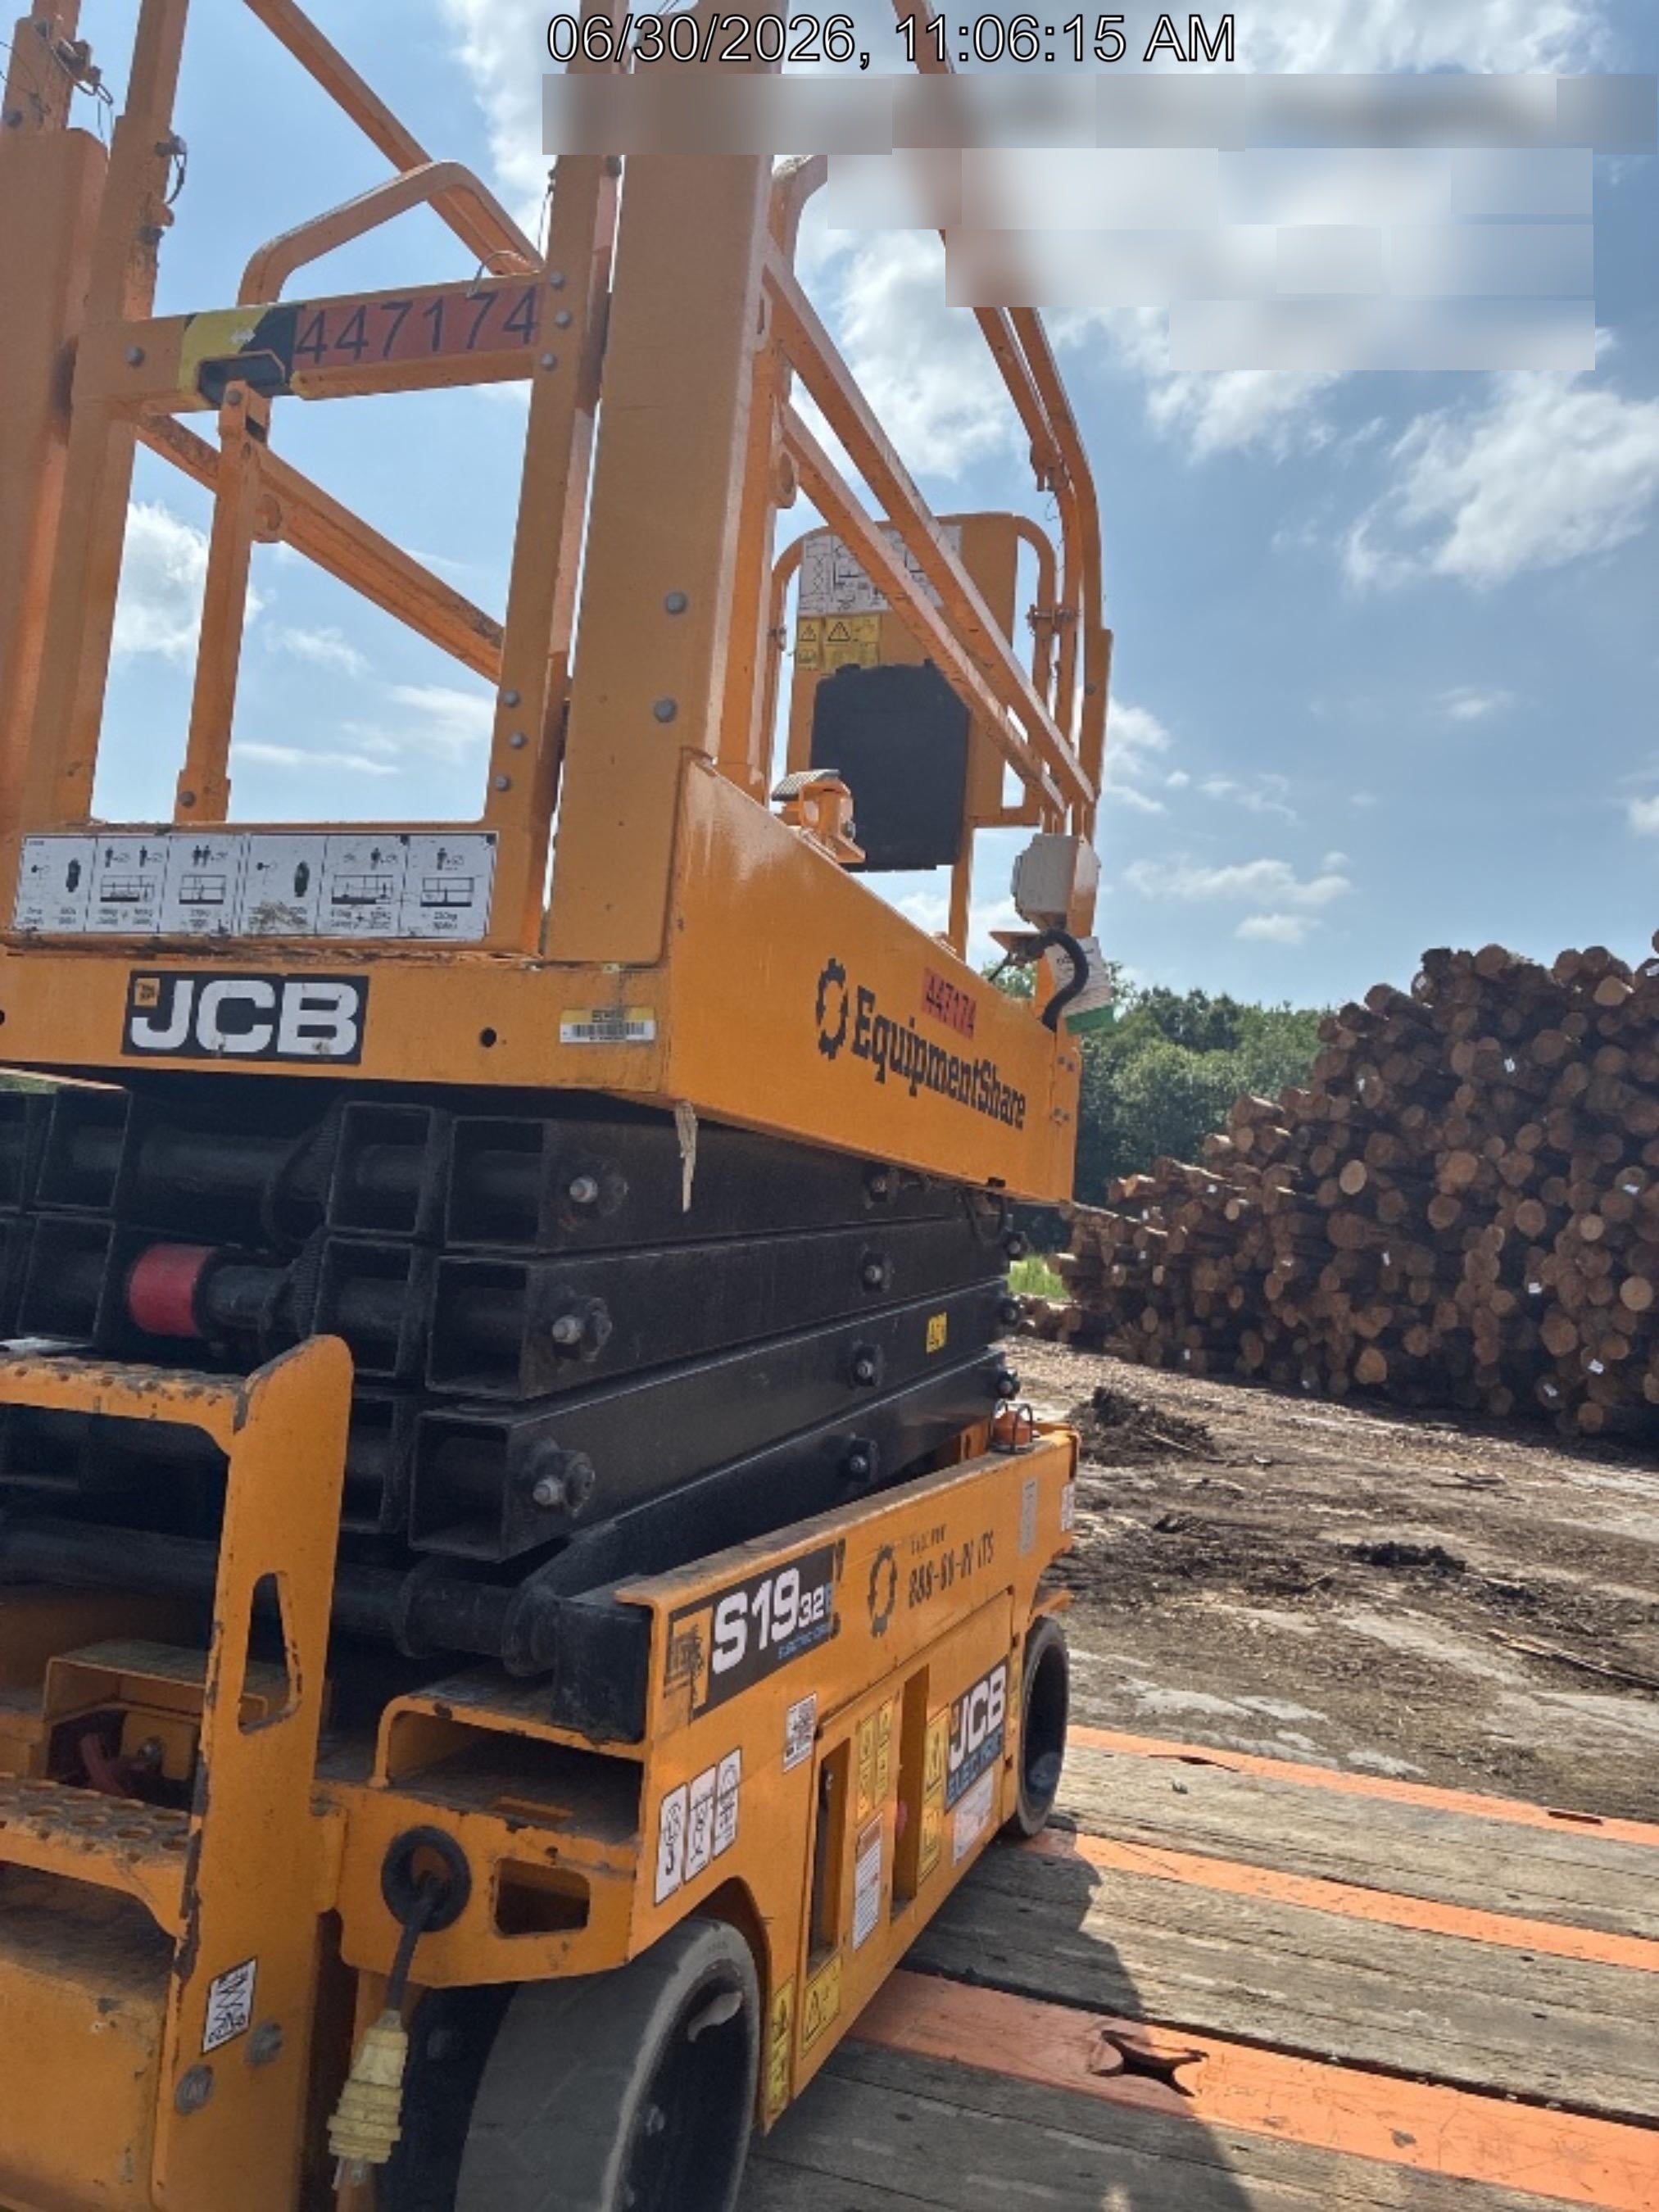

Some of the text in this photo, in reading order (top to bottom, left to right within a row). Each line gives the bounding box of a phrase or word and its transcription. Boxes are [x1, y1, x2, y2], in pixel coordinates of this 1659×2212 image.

[296, 287, 538, 363] 447174
[131, 980, 360, 1055] JCB
[927, 976, 976, 1039] 447174
[851, 985, 1027, 1130] EquipmentShare
[950, 1665, 1006, 1771] JCB
